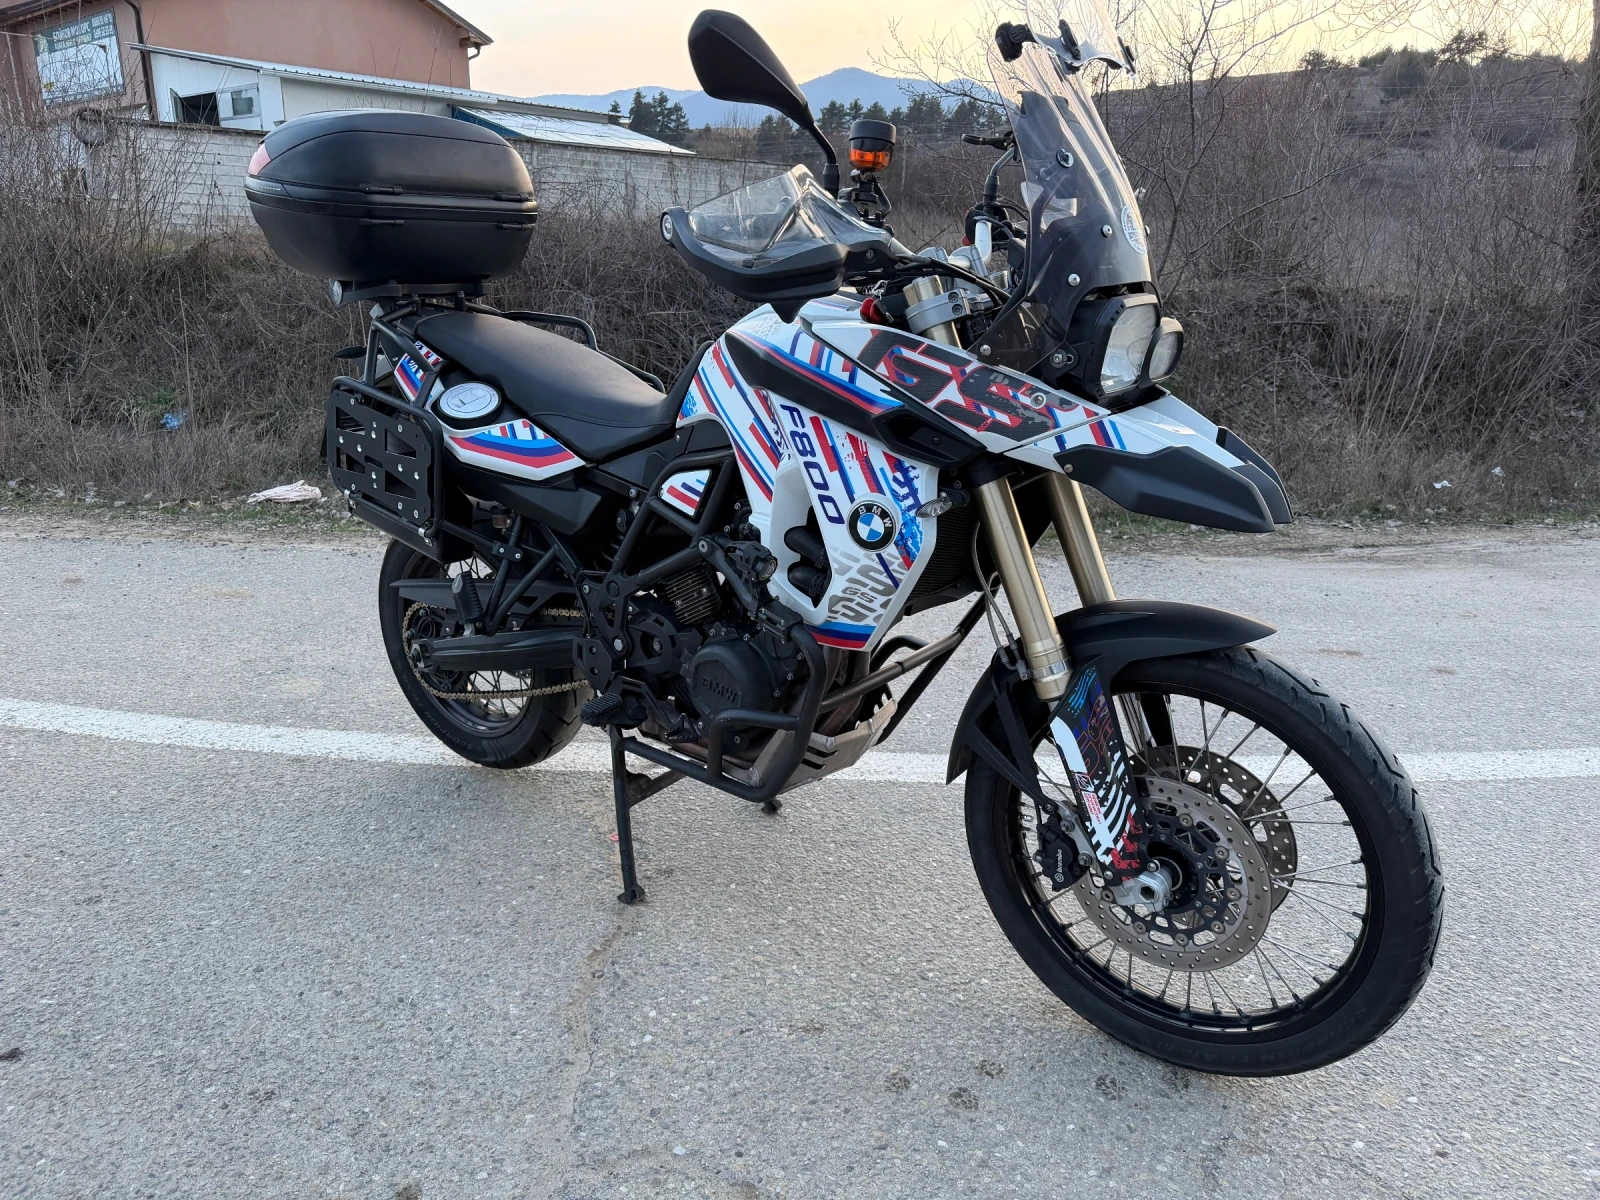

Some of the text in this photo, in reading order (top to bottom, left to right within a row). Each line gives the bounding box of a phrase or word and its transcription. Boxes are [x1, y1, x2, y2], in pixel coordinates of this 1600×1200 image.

[780, 403, 845, 525] F800
[858, 505, 893, 528] BMW
[702, 675, 738, 703] BMW
